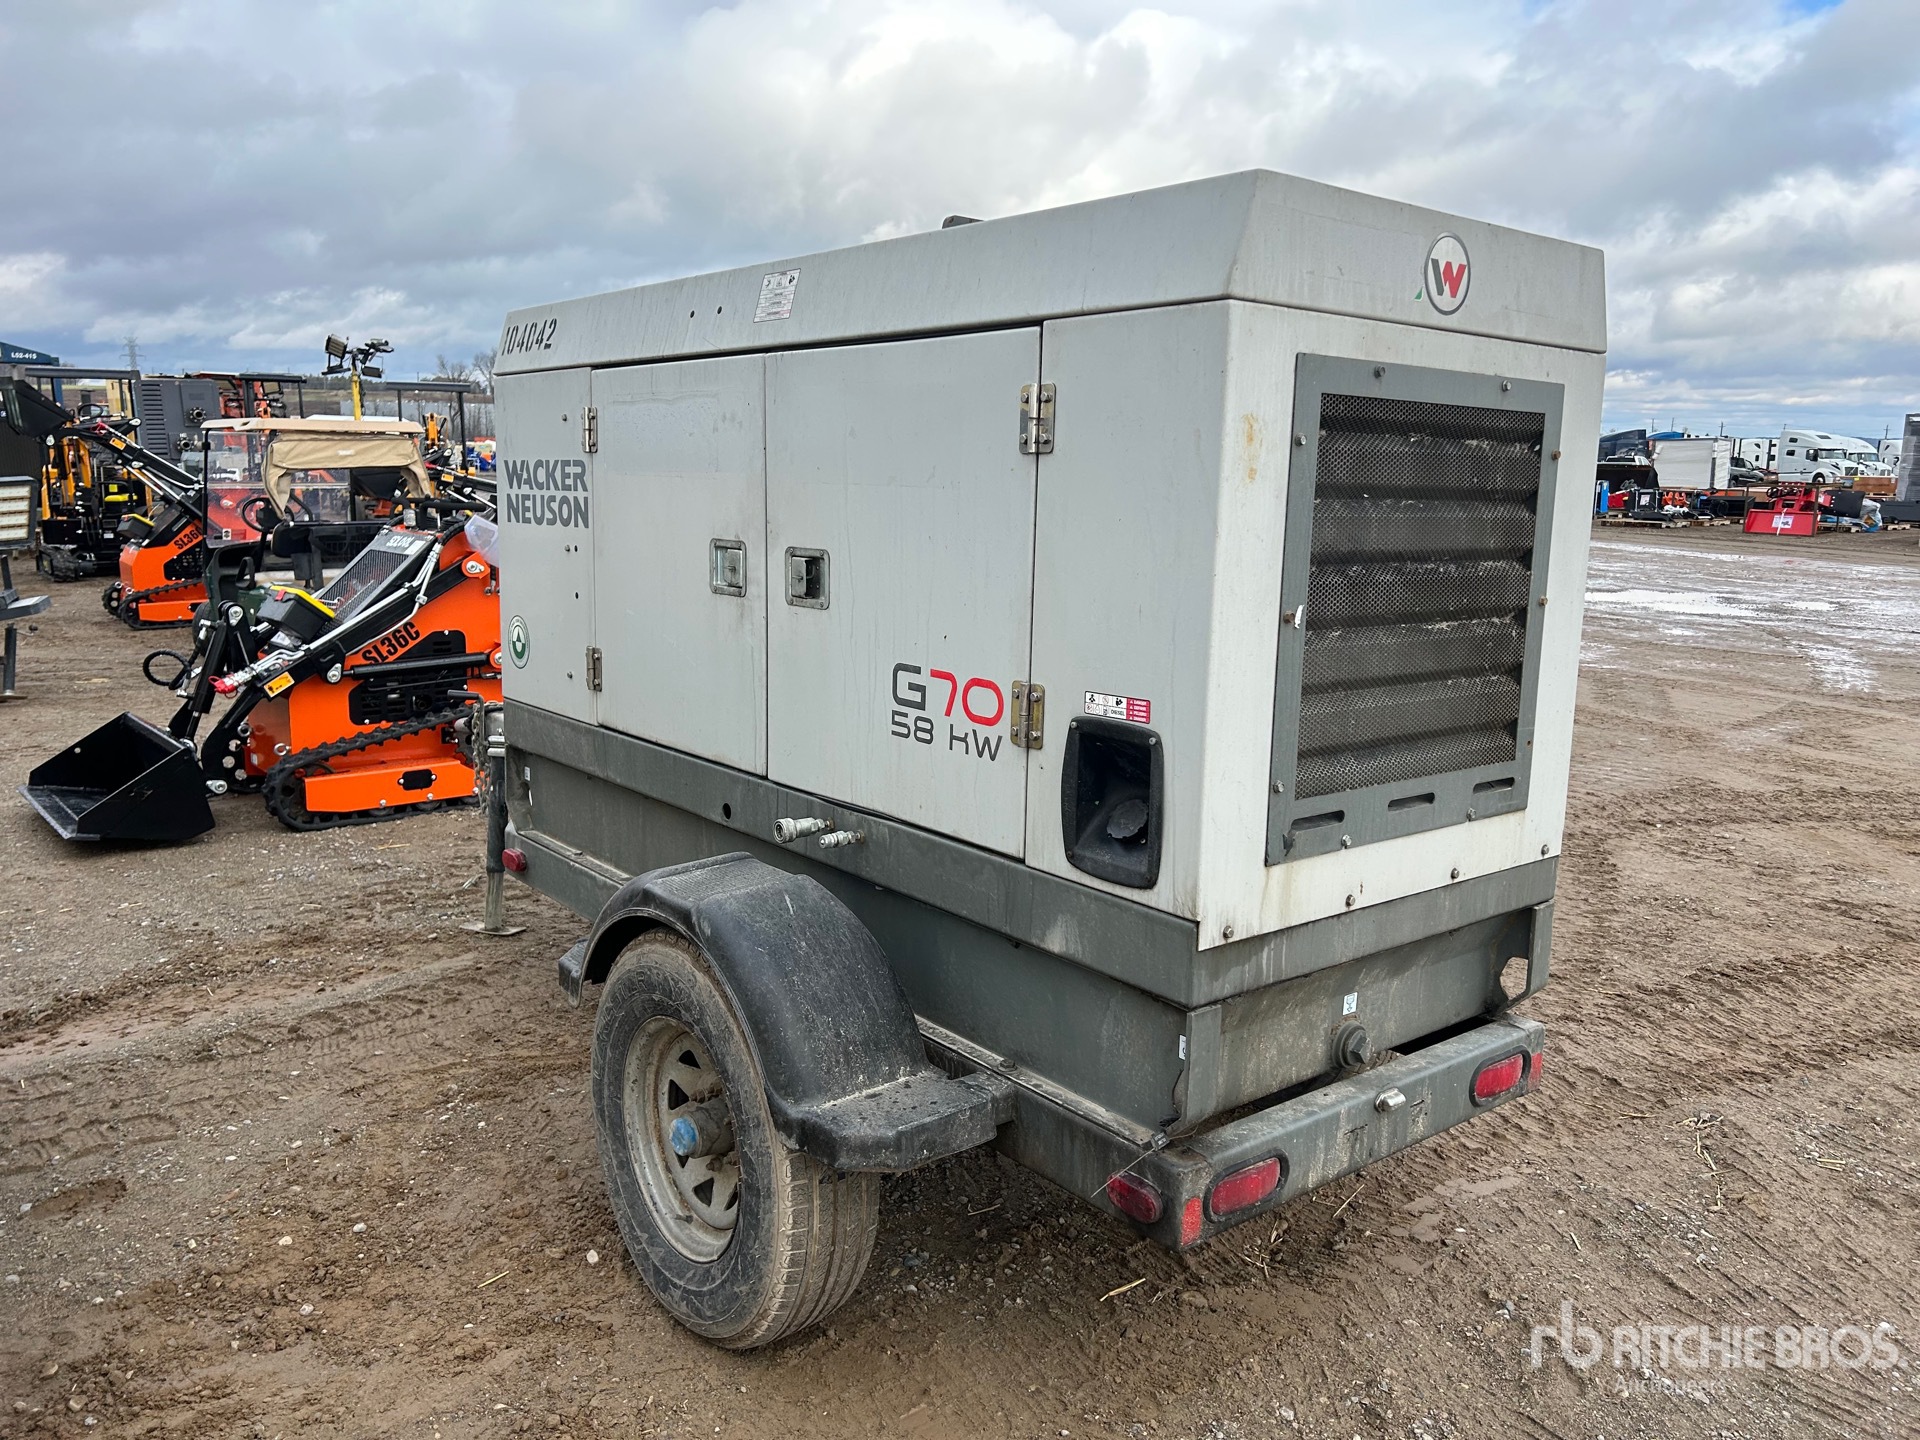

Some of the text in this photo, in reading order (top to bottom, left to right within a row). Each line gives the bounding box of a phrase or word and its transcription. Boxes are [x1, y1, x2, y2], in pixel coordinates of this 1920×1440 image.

[501, 318, 557, 356] 104042
[503, 459, 589, 492] WACKER
[506, 493, 589, 529] NEUSON
[361, 621, 420, 664] SL36C
[891, 662, 1004, 727] G70
[1110, 708, 1125, 717] DIESEL
[890, 709, 934, 745] 58
